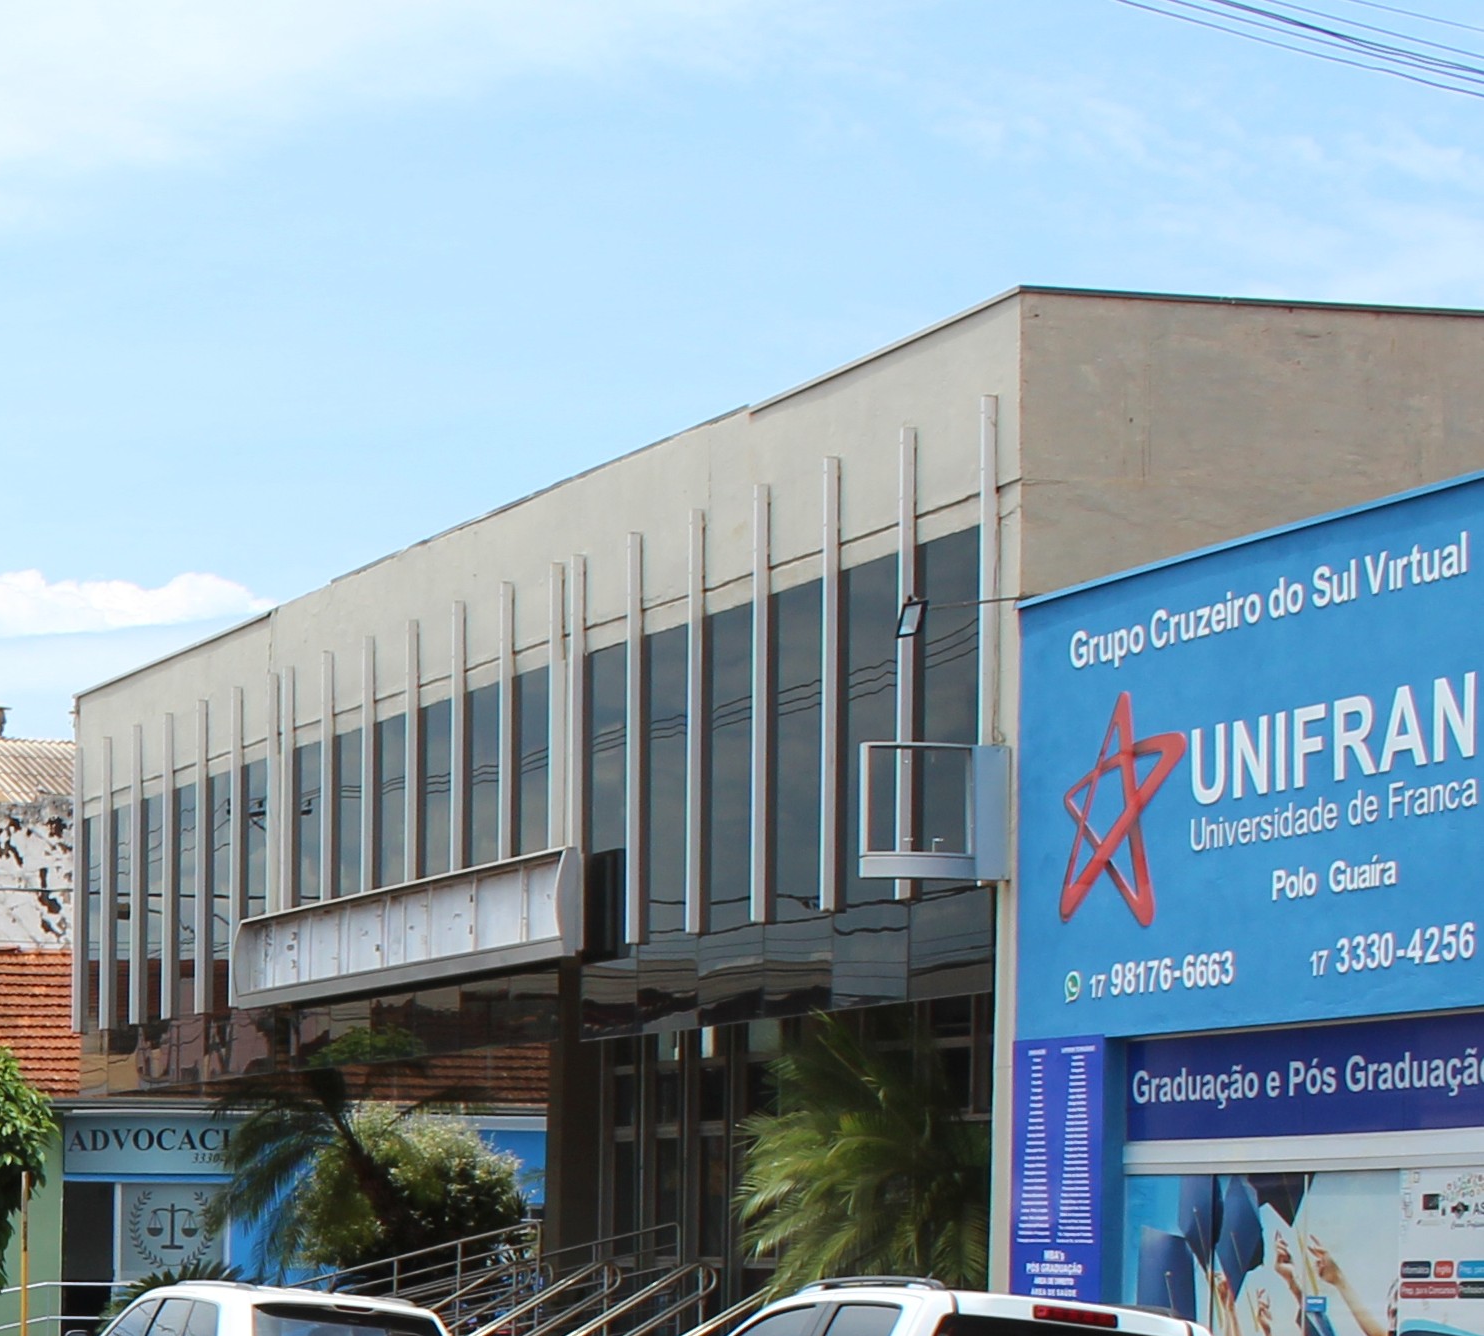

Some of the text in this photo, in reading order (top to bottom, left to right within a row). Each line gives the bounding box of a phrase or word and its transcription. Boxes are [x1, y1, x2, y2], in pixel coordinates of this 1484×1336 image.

[1070, 531, 1469, 669] Grupo Cruzeiro do Sul Virtual
[1191, 671, 1477, 805] UNIFRAN
[1190, 778, 1479, 853] Universidade de Franca
[1271, 854, 1398, 901] Polo Guaíra
[1089, 950, 1235, 998] 17 98176-6663
[1309, 921, 1476, 977] 17 3330-4256
[1133, 1064, 1260, 1109] Graduação
[1266, 1070, 1281, 1098] e
[1288, 1057, 1337, 1098] Pós
